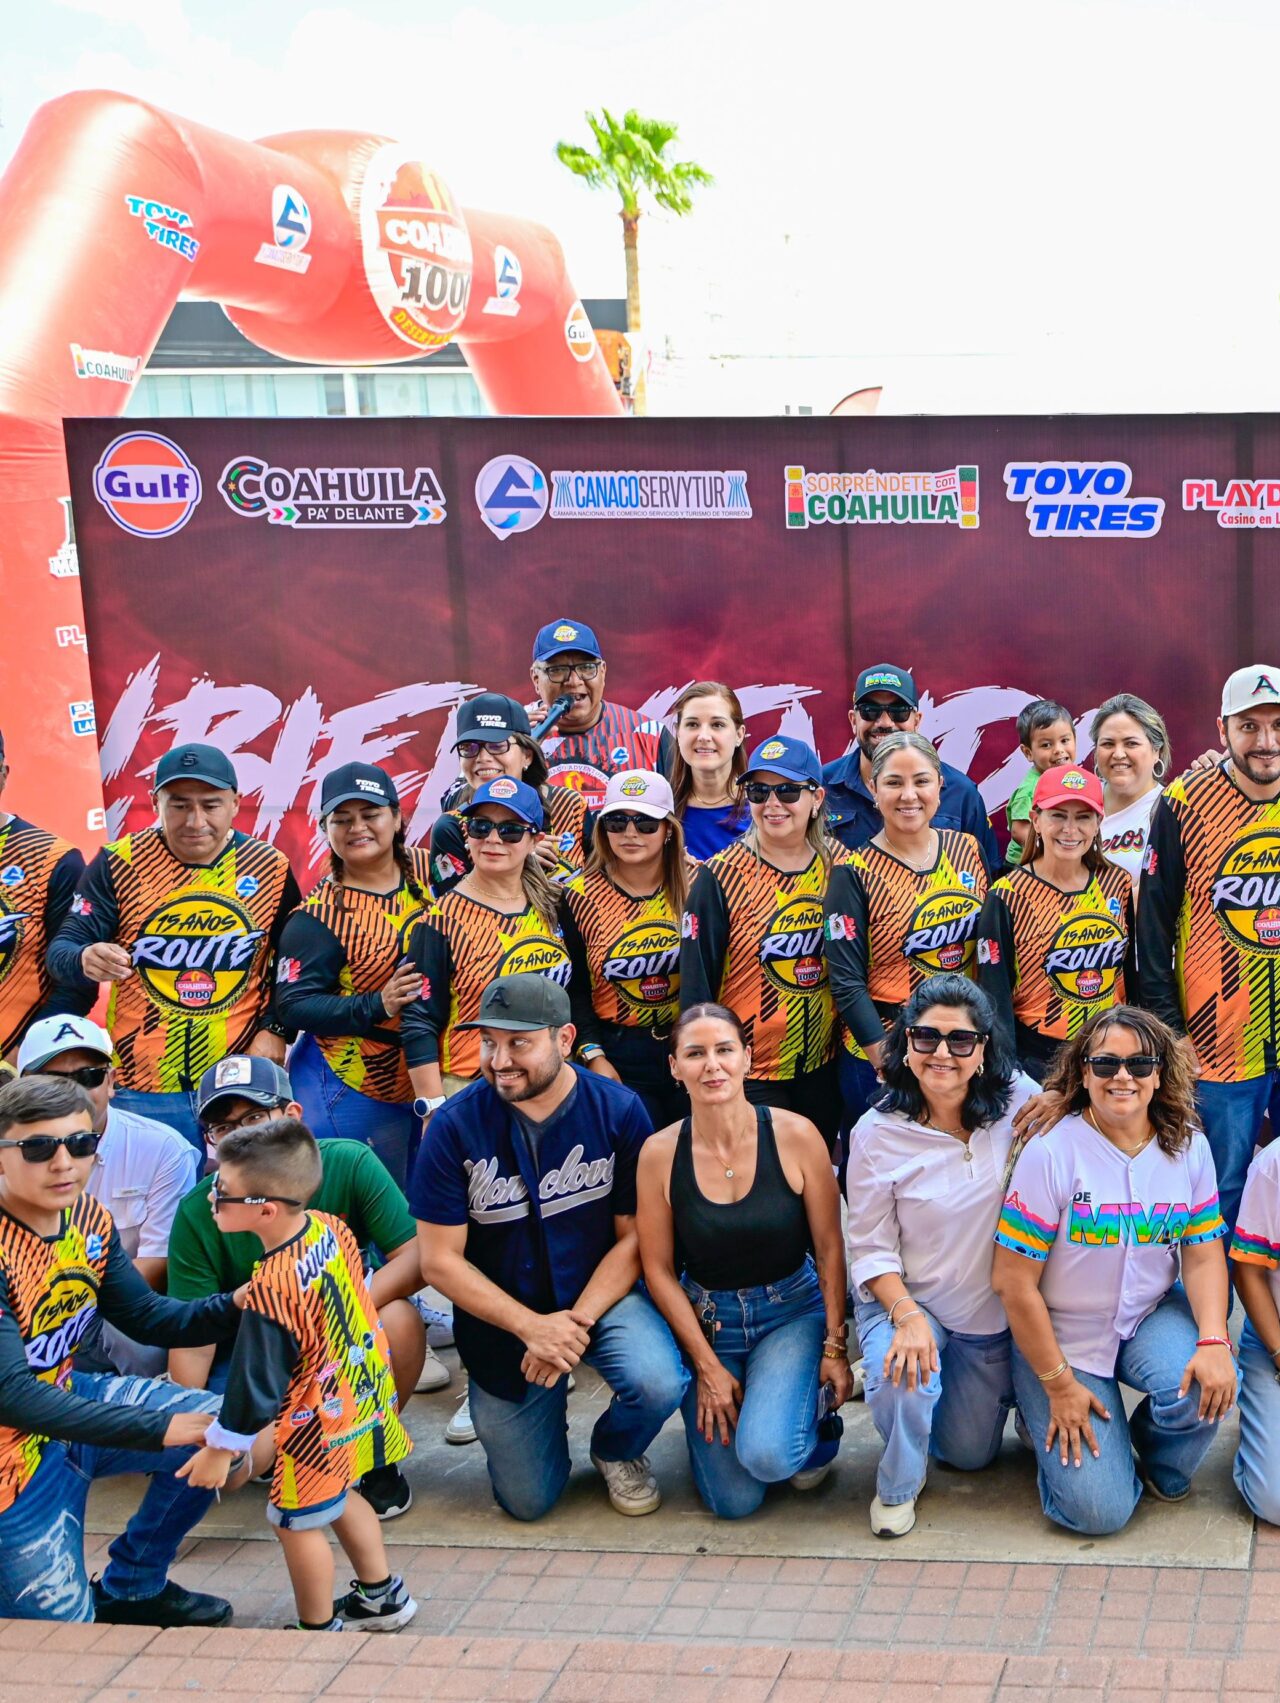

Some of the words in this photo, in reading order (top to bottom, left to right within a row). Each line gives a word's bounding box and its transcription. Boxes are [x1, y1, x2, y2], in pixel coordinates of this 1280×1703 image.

[145, 221, 199, 261] TIRES
[104, 470, 190, 499] Gulf
[221, 458, 444, 516] COAHUILA
[807, 470, 932, 493] SORPRÉNDETE
[935, 476, 956, 490] con
[1010, 467, 1127, 496] TOYO
[334, 507, 405, 521] DELANTE
[808, 494, 957, 521] COAHUILA
[1032, 503, 1159, 532] TIRES
[1221, 512, 1256, 525] Casino
[1259, 516, 1272, 525] en
[481, 721, 507, 729] TIRES
[355, 779, 376, 789] TOYO
[1231, 851, 1253, 874] 15
[155, 913, 179, 933] 15
[177, 909, 238, 932] AÑOS
[778, 912, 793, 928] 15
[791, 907, 824, 929] AÑO
[920, 911, 936, 928] 15
[934, 901, 975, 924] AÑOS
[619, 938, 638, 952] 15
[636, 930, 680, 951] AÑOS
[1063, 931, 1078, 947] 15
[1076, 923, 1116, 943] AÑOS
[130, 927, 268, 972] ROUTE
[509, 958, 525, 974] 15
[524, 948, 562, 970] AÑOS
[1046, 936, 1129, 972] ROUTE
[53, 1022, 84, 1043] A
[244, 1197, 266, 1205] Gulf
[1073, 1191, 1092, 1203] DE
